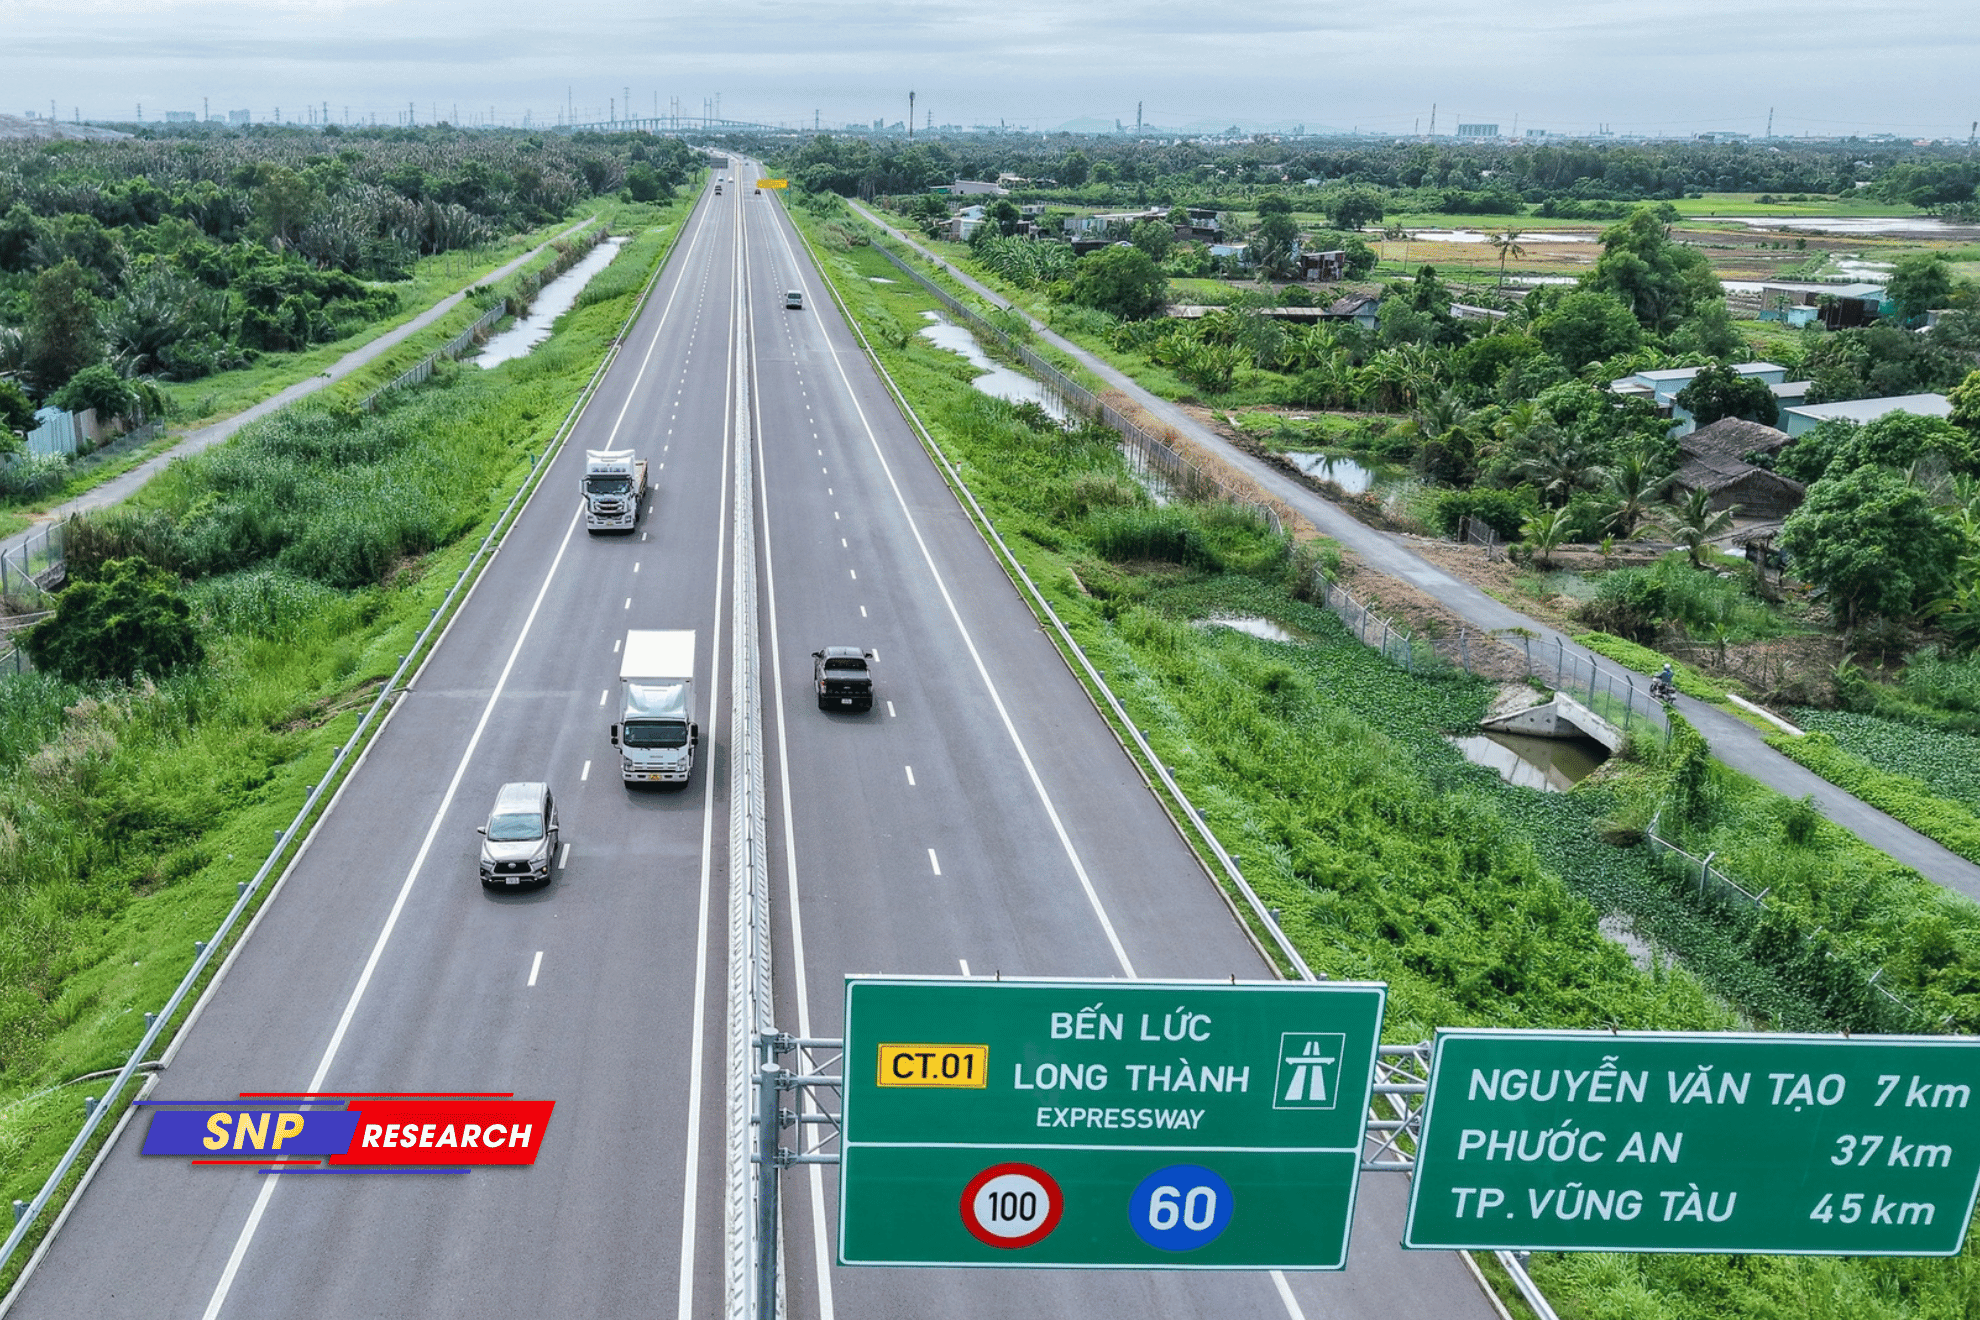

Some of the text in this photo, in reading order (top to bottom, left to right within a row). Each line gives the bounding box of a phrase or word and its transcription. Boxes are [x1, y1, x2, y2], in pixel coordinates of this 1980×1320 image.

[1050, 1002, 1212, 1042] BẾN LỨC
[892, 1052, 977, 1079] CT.01
[1014, 1057, 1250, 1093] LONG THÀNH
[1468, 1055, 1649, 1103] NGUYỄN
[1667, 1063, 1752, 1105] VĂN
[1768, 1073, 1846, 1112] TẠO
[1036, 1106, 1206, 1130] EXPRESSWAY
[1457, 1118, 1607, 1163] PHƯỚC
[1616, 1131, 1684, 1164] AN
[987, 1191, 1037, 1222] 100
[1148, 1185, 1217, 1231] 60
[1451, 1187, 1514, 1219] TP.
[1528, 1181, 1643, 1221] VŨNG
[1659, 1182, 1737, 1223] TÀU
